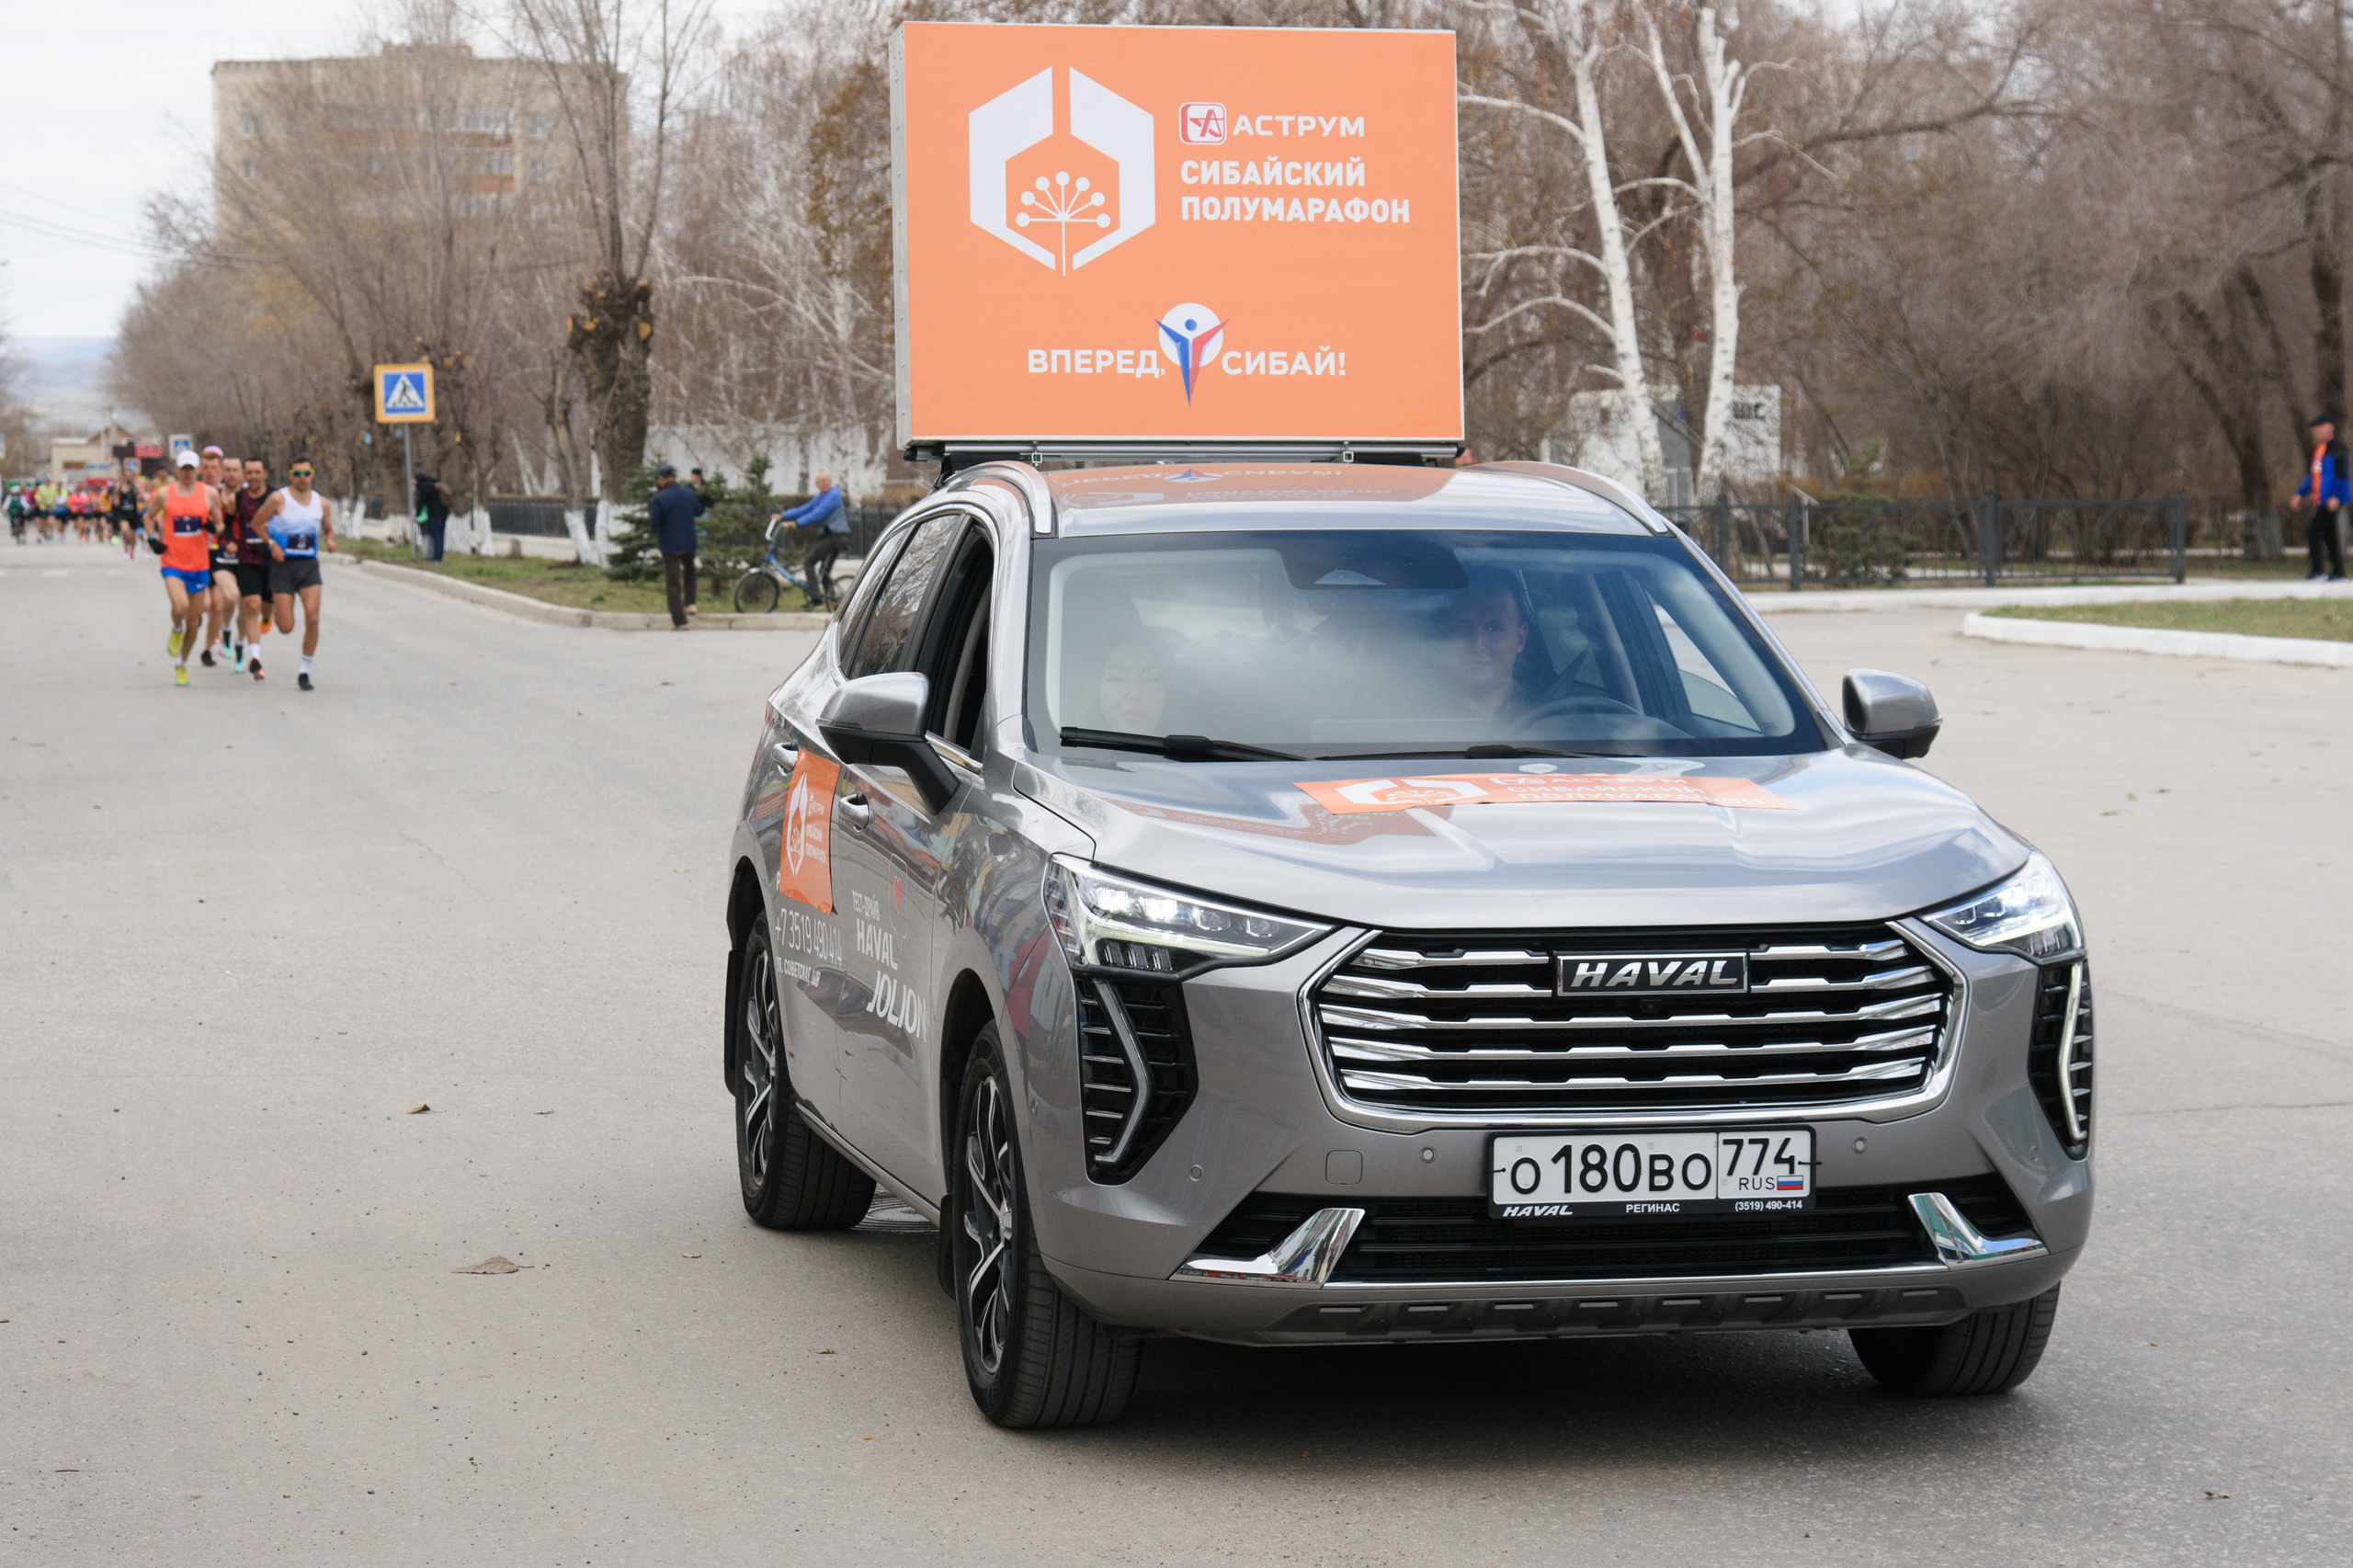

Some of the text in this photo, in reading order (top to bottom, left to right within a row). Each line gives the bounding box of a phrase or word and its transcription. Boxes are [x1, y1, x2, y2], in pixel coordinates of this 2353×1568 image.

[1232, 114, 1365, 138] АСТРУМ
[1180, 154, 1366, 187] СИБАЙСКИЙ
[1181, 196, 1410, 223] ПОЛУМАРАФОН
[1027, 345, 1347, 379] ВПЕРЕД, СИБАЙ!
[775, 907, 843, 968] +7 3519 490 414
[857, 917, 899, 971] HAVAL
[1570, 960, 1738, 988] HAVAL
[866, 970, 927, 1044] JOLION
[1722, 1136, 1796, 1177] 774
[1738, 1176, 1776, 1191] RUS
[1502, 1204, 1574, 1218] HAVAL
[1625, 1202, 1681, 1214] РЕГИНАС
[1734, 1199, 1803, 1212] (3519) 490-414
